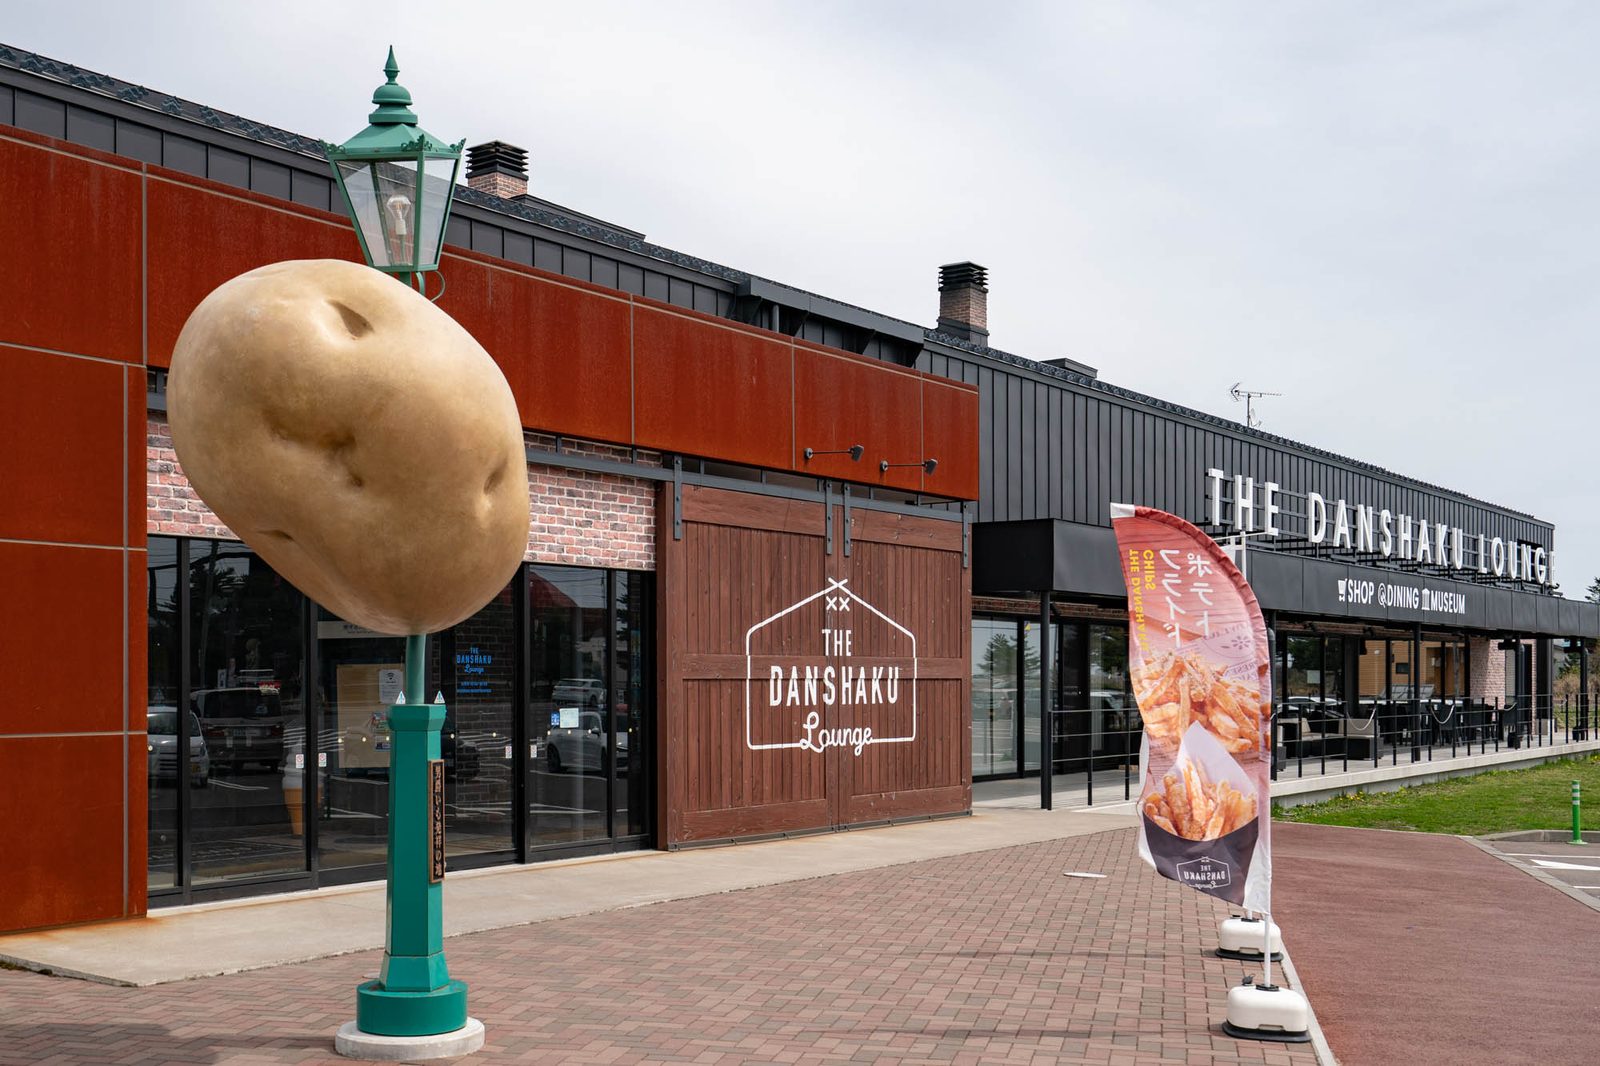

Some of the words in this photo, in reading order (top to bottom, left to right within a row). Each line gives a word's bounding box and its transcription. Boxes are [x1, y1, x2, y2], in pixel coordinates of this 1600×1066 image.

[1208, 468, 1279, 536] THE
[1308, 491, 1463, 570] DANSHAKU
[1478, 533, 1557, 588] LOUNGE
[1348, 579, 1375, 604] SHOP
[1387, 584, 1419, 609] DINING
[1431, 590, 1466, 614] MUSEUM
[822, 628, 852, 657] THE
[769, 665, 899, 707] DANSHAKU
[799, 711, 873, 756] Lounge
